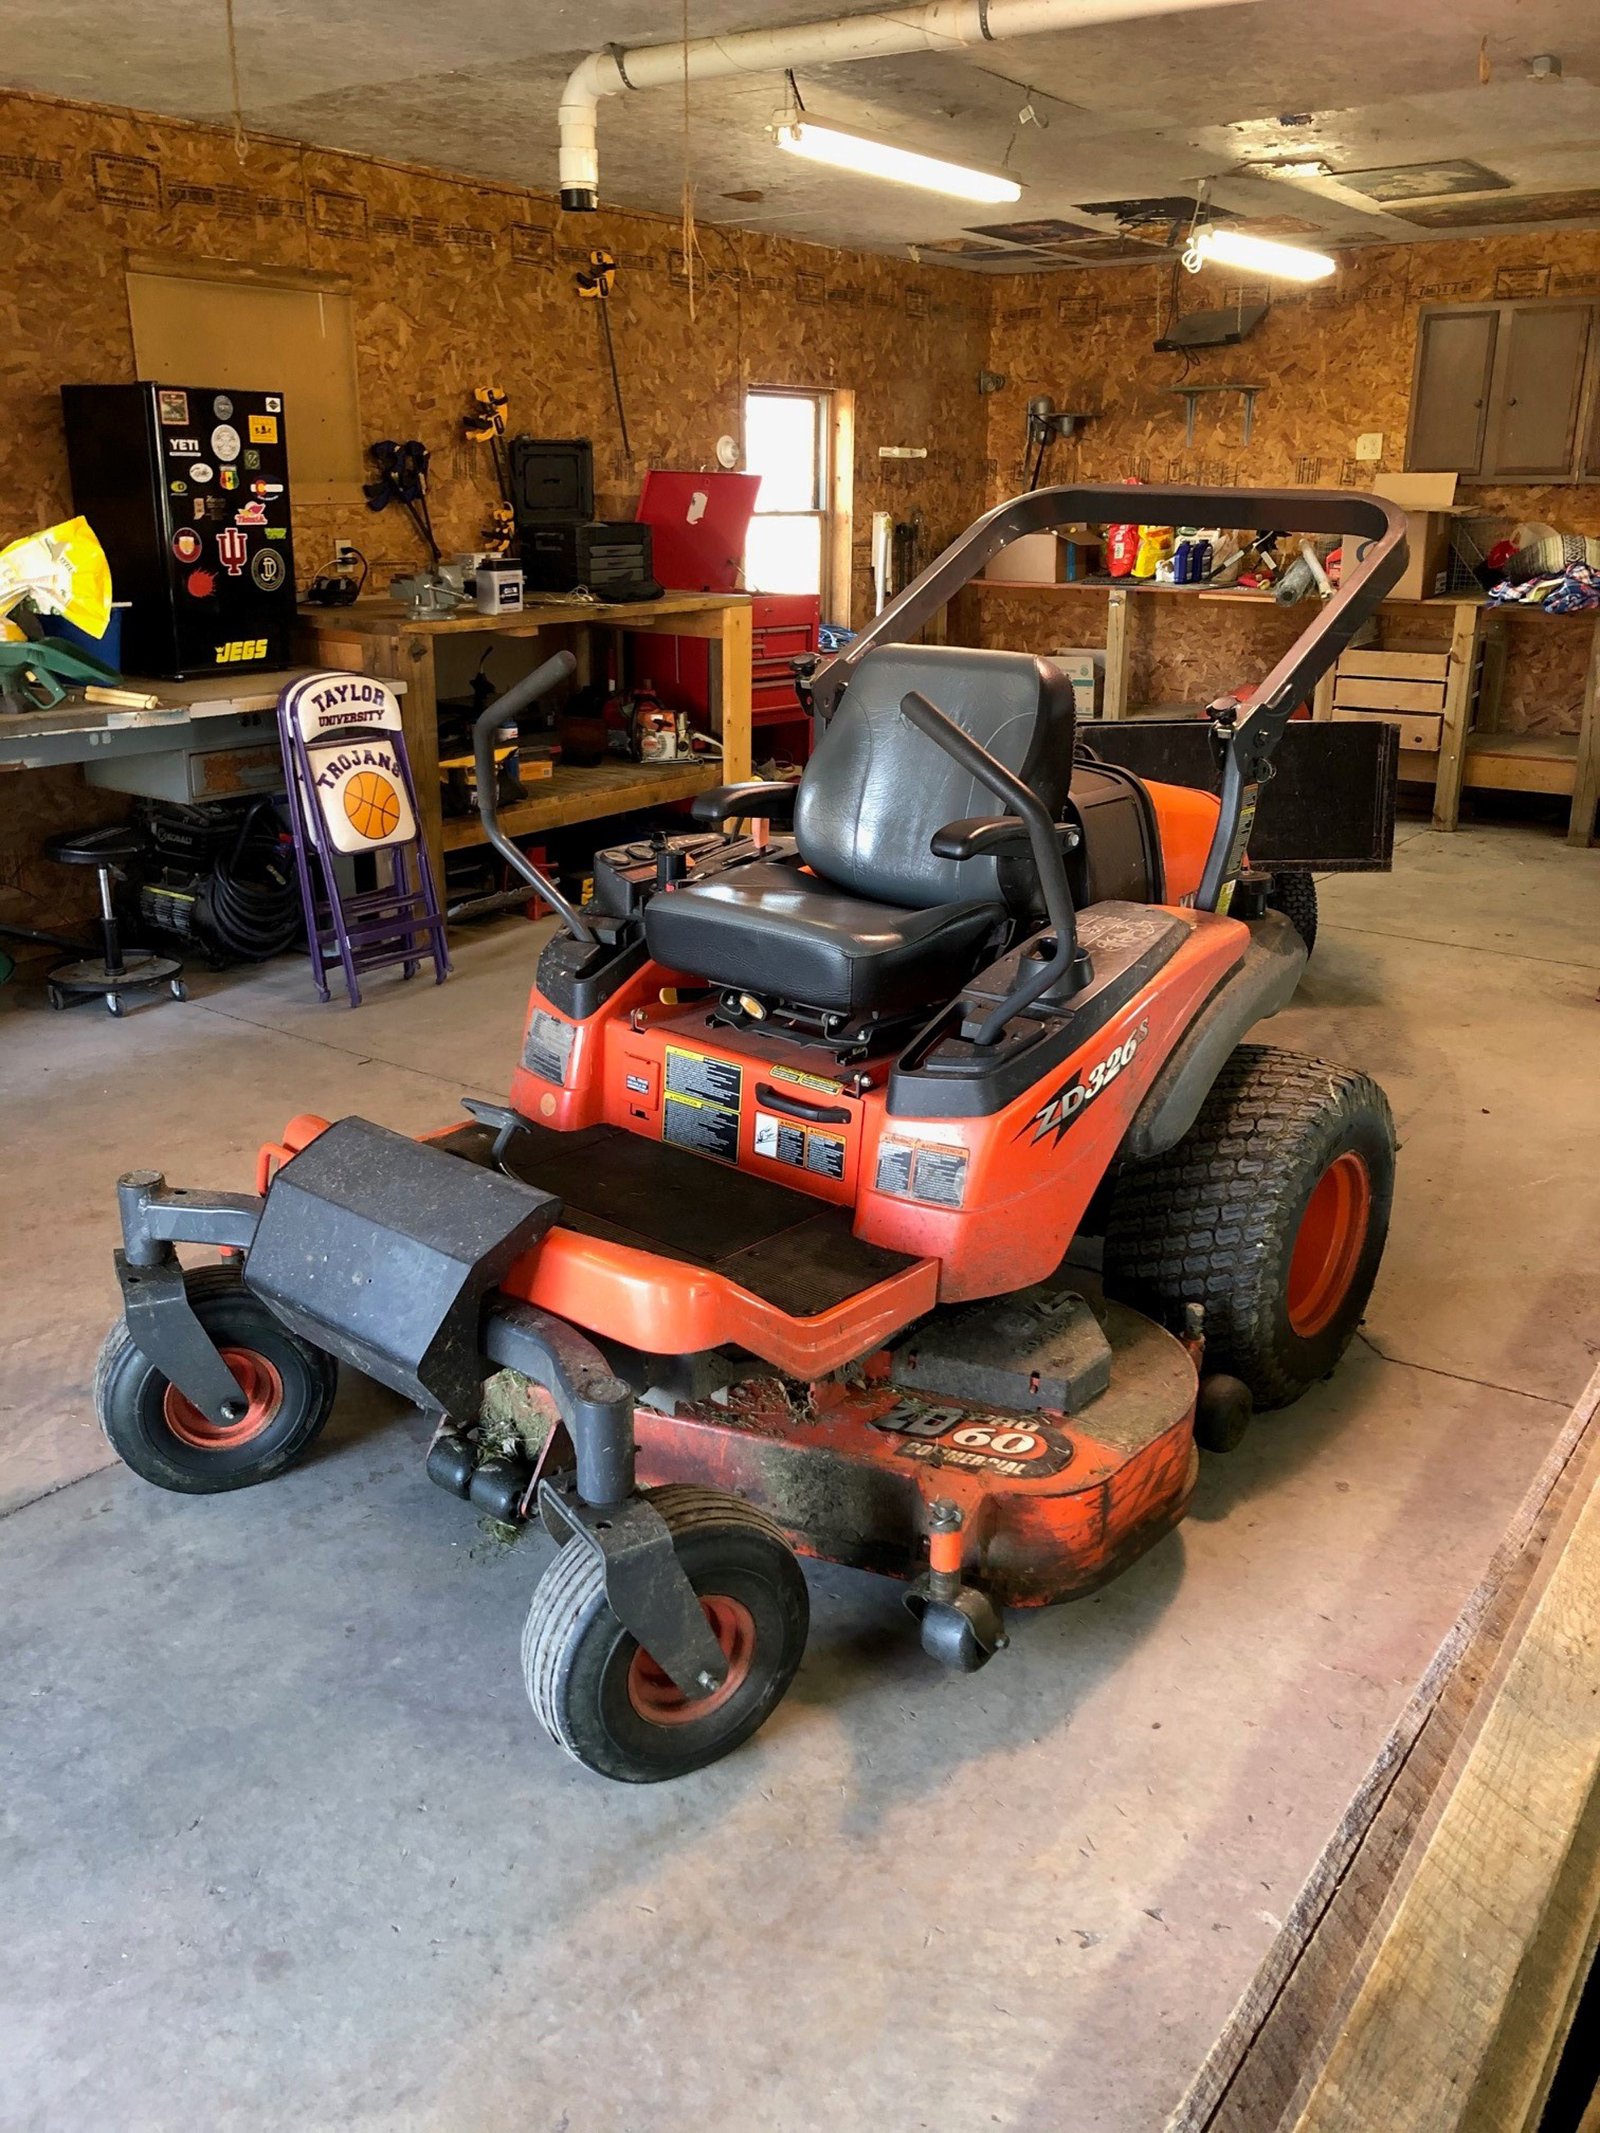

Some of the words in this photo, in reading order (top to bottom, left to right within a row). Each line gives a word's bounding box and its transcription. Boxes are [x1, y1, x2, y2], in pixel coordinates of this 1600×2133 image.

[169, 438, 199, 451] YETI
[216, 638, 268, 664] JEGS
[311, 683, 385, 713] TAYLOR
[318, 709, 385, 728] UNIVERSITY
[870, 1400, 965, 1438] ZD
[952, 1426, 1037, 1455] 60
